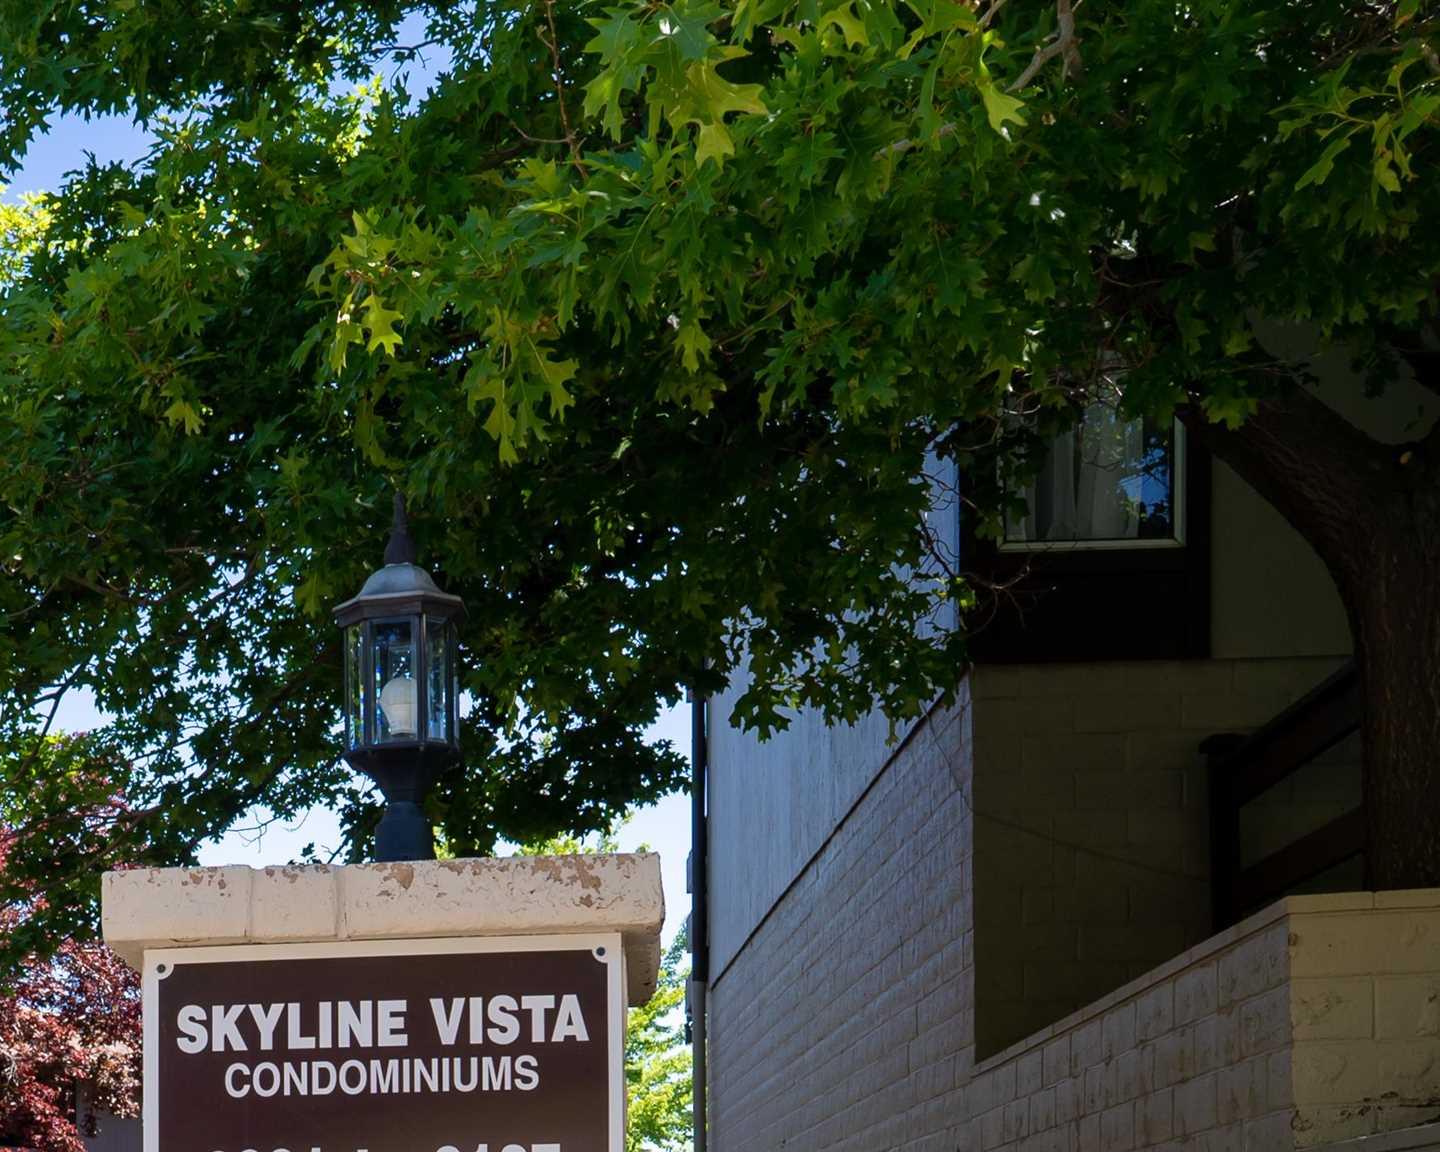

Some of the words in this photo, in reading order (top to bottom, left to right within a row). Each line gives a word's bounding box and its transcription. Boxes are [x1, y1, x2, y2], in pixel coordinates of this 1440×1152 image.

[176, 1000, 408, 1054] SKYLINE
[429, 994, 590, 1045] VISTA
[224, 1055, 540, 1098] CONDOMINIUMS
